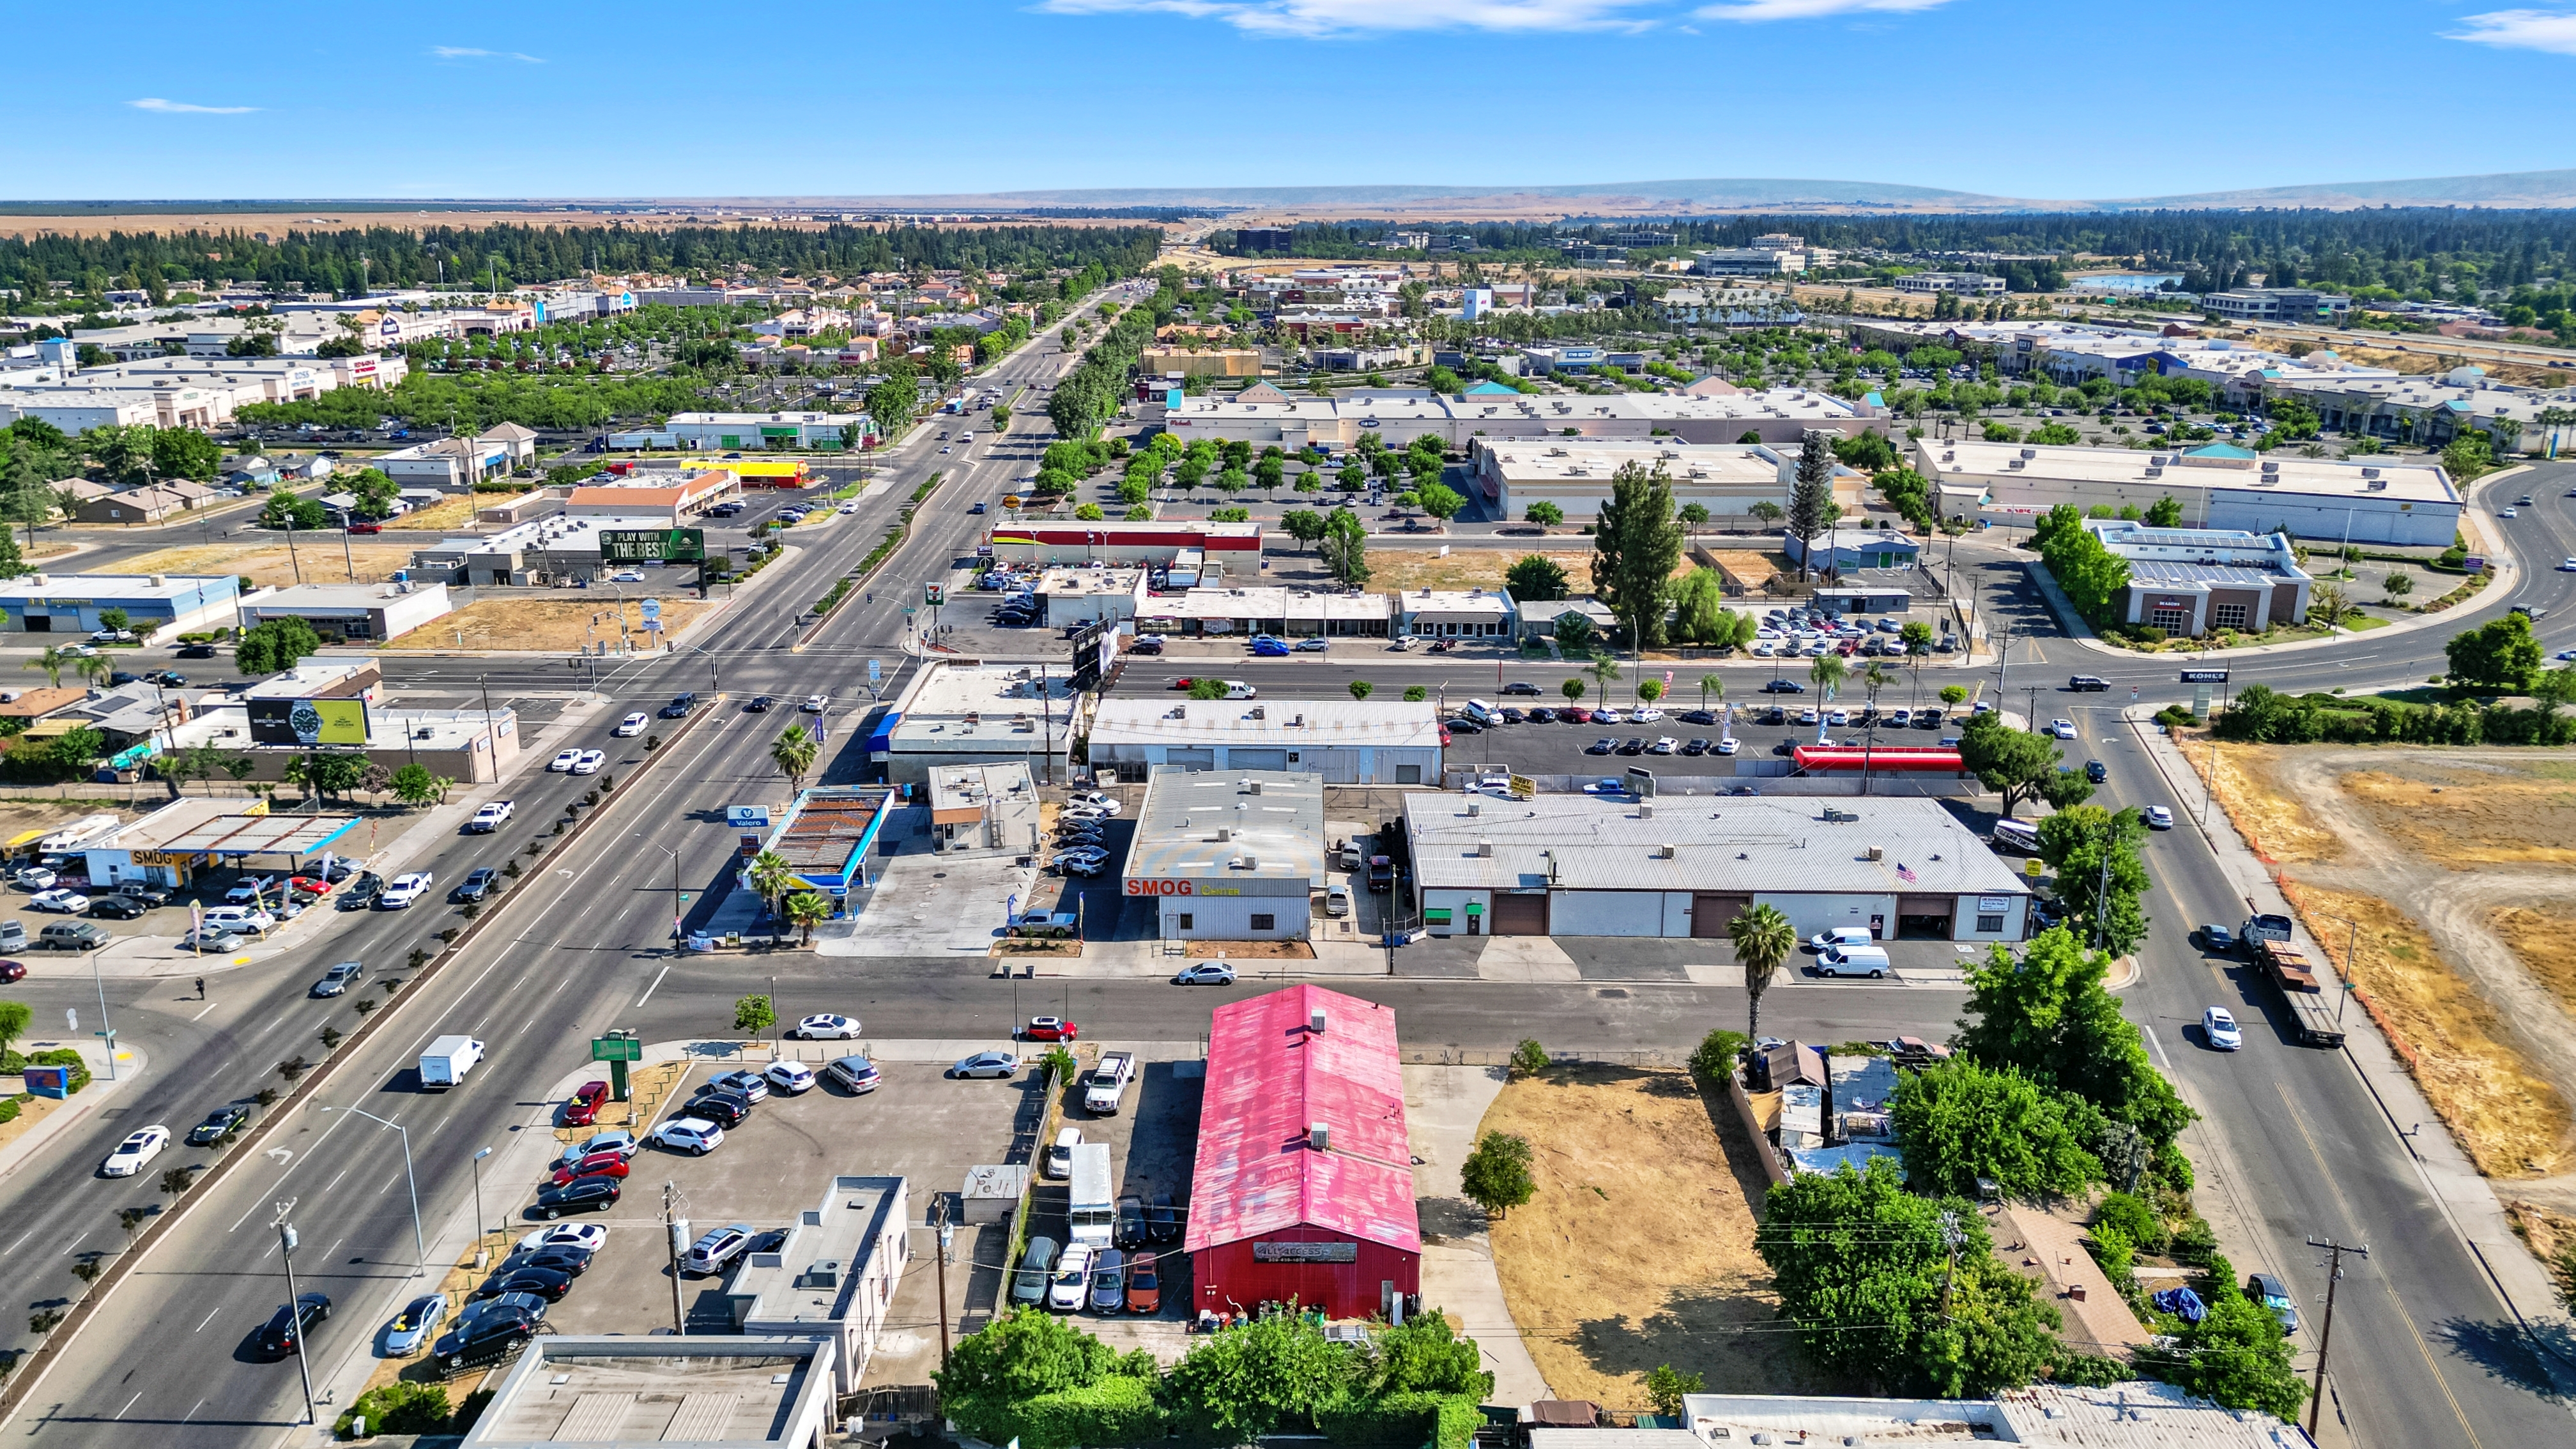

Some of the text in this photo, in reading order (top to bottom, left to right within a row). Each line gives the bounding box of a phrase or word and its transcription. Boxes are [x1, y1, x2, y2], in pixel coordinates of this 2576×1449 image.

[617, 532, 660, 542] PLAY WITH
[612, 542, 636, 558] THE
[636, 542, 667, 558] BEST
[134, 851, 172, 864] SMOG
[1128, 880, 1240, 895] SMOG CENTER
[1282, 1246, 1322, 1256] ACCESS
